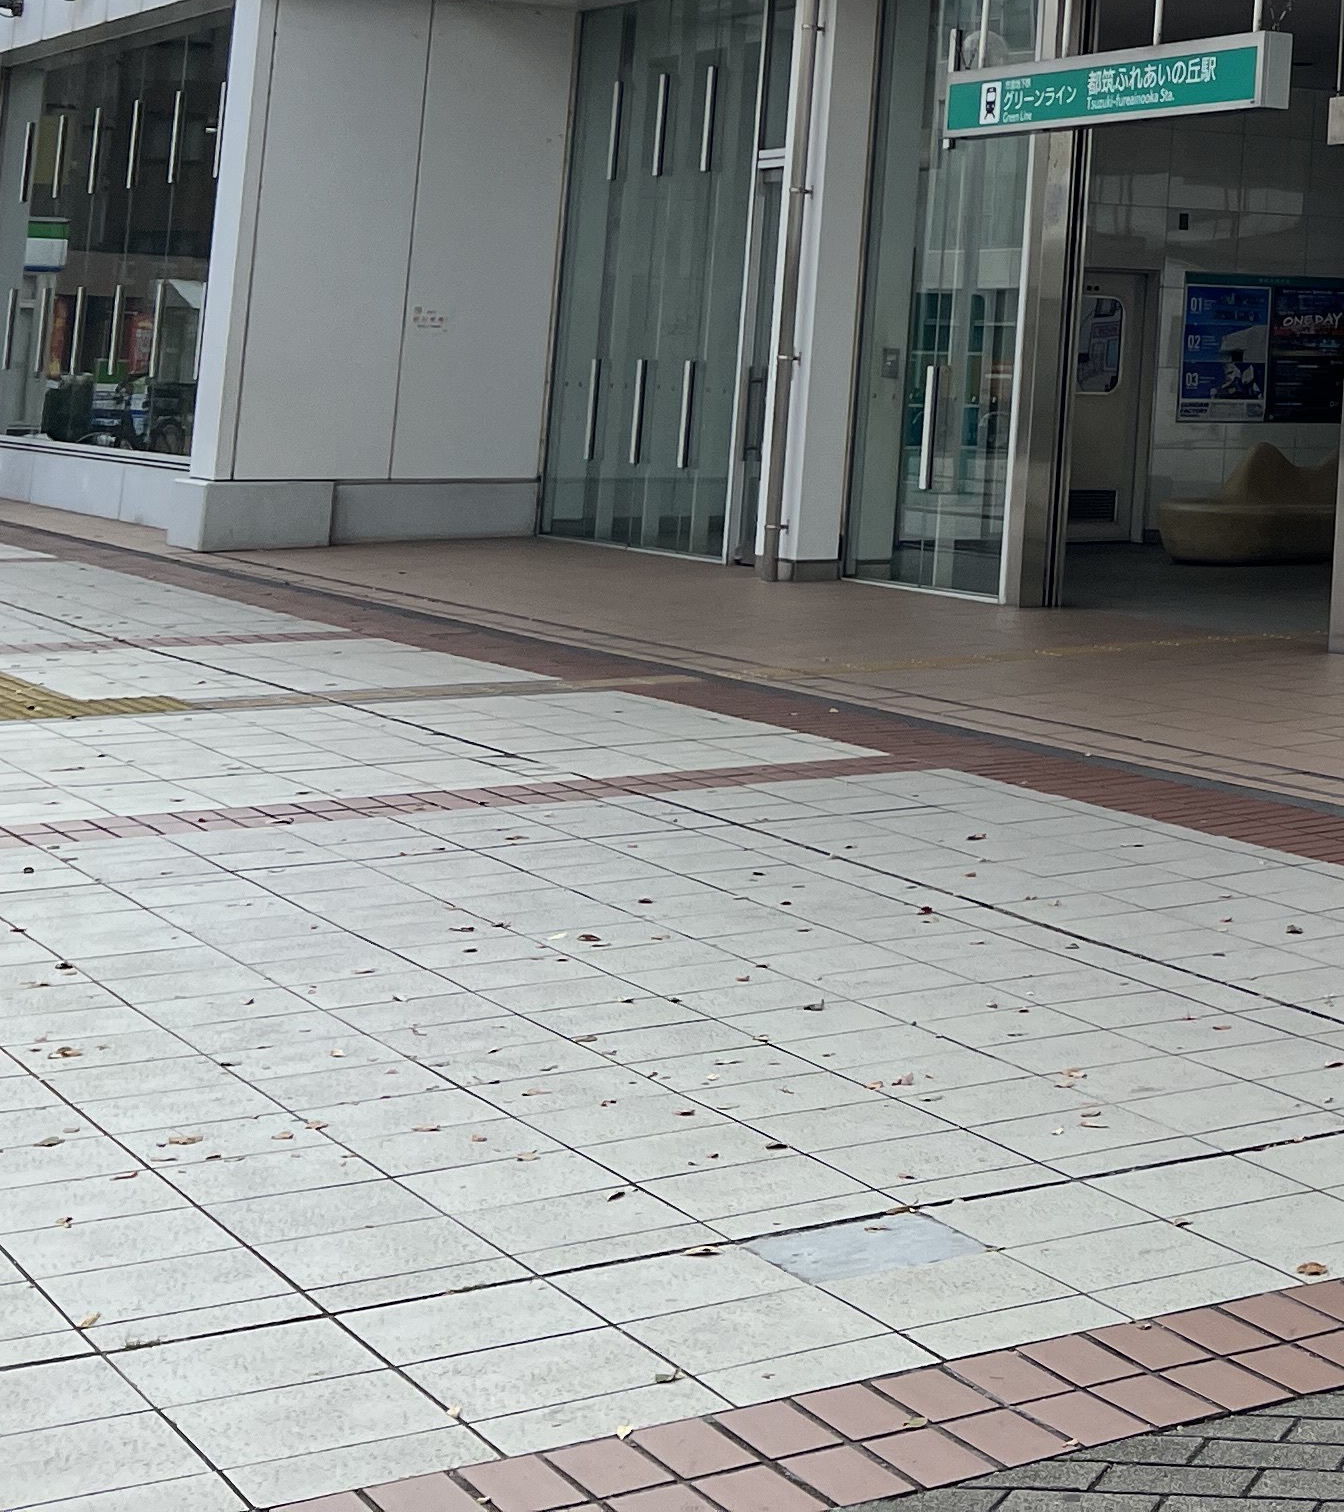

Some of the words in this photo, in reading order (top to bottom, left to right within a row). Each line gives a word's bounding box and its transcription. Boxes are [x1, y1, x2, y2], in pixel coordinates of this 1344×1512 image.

[1086, 56, 1217, 96] 都筑ふれあいの丘駅
[1002, 85, 1077, 111] グリーンライン
[1002, 111, 1019, 124] Green
[1020, 109, 1032, 122] Line
[1190, 296, 1203, 312] 01
[1187, 334, 1201, 349] 02
[1185, 372, 1199, 387] 03
